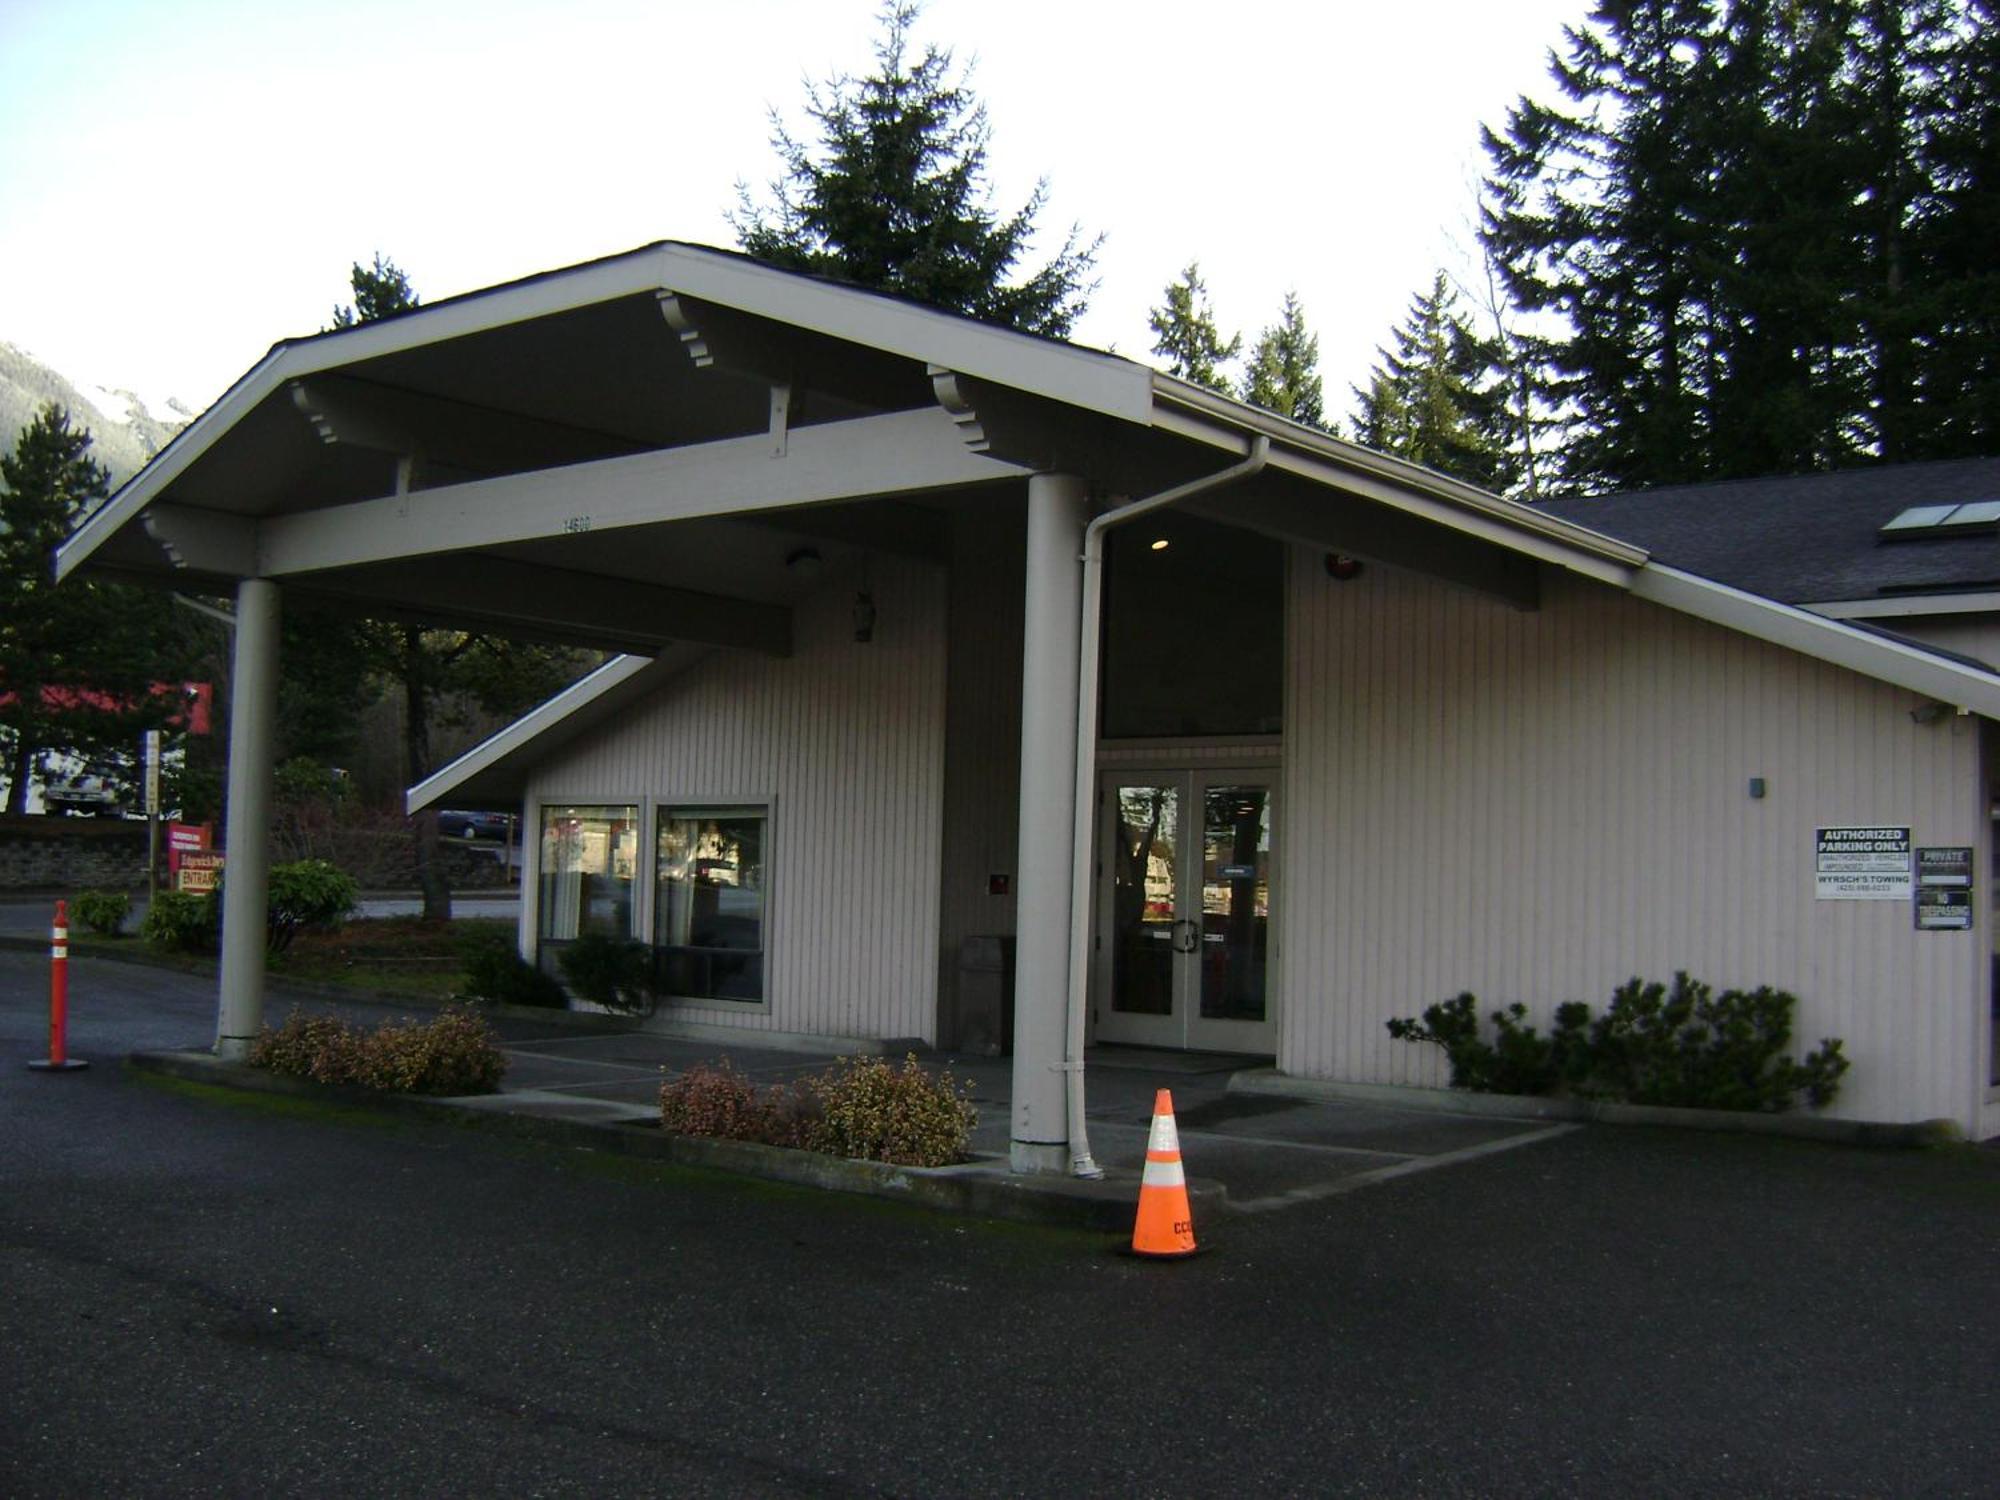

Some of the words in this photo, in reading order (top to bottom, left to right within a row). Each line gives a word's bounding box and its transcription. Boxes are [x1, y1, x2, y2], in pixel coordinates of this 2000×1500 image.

[1824, 830, 1903, 840] AUTHORIZED
[1819, 841, 1873, 852] PARKING
[1874, 840, 1908, 851] ONLY
[1923, 851, 1964, 862] PRIVATE
[1818, 875, 1868, 883] WYRSCH'S
[1870, 875, 1909, 883] TOWING
[1936, 893, 1949, 905] NO
